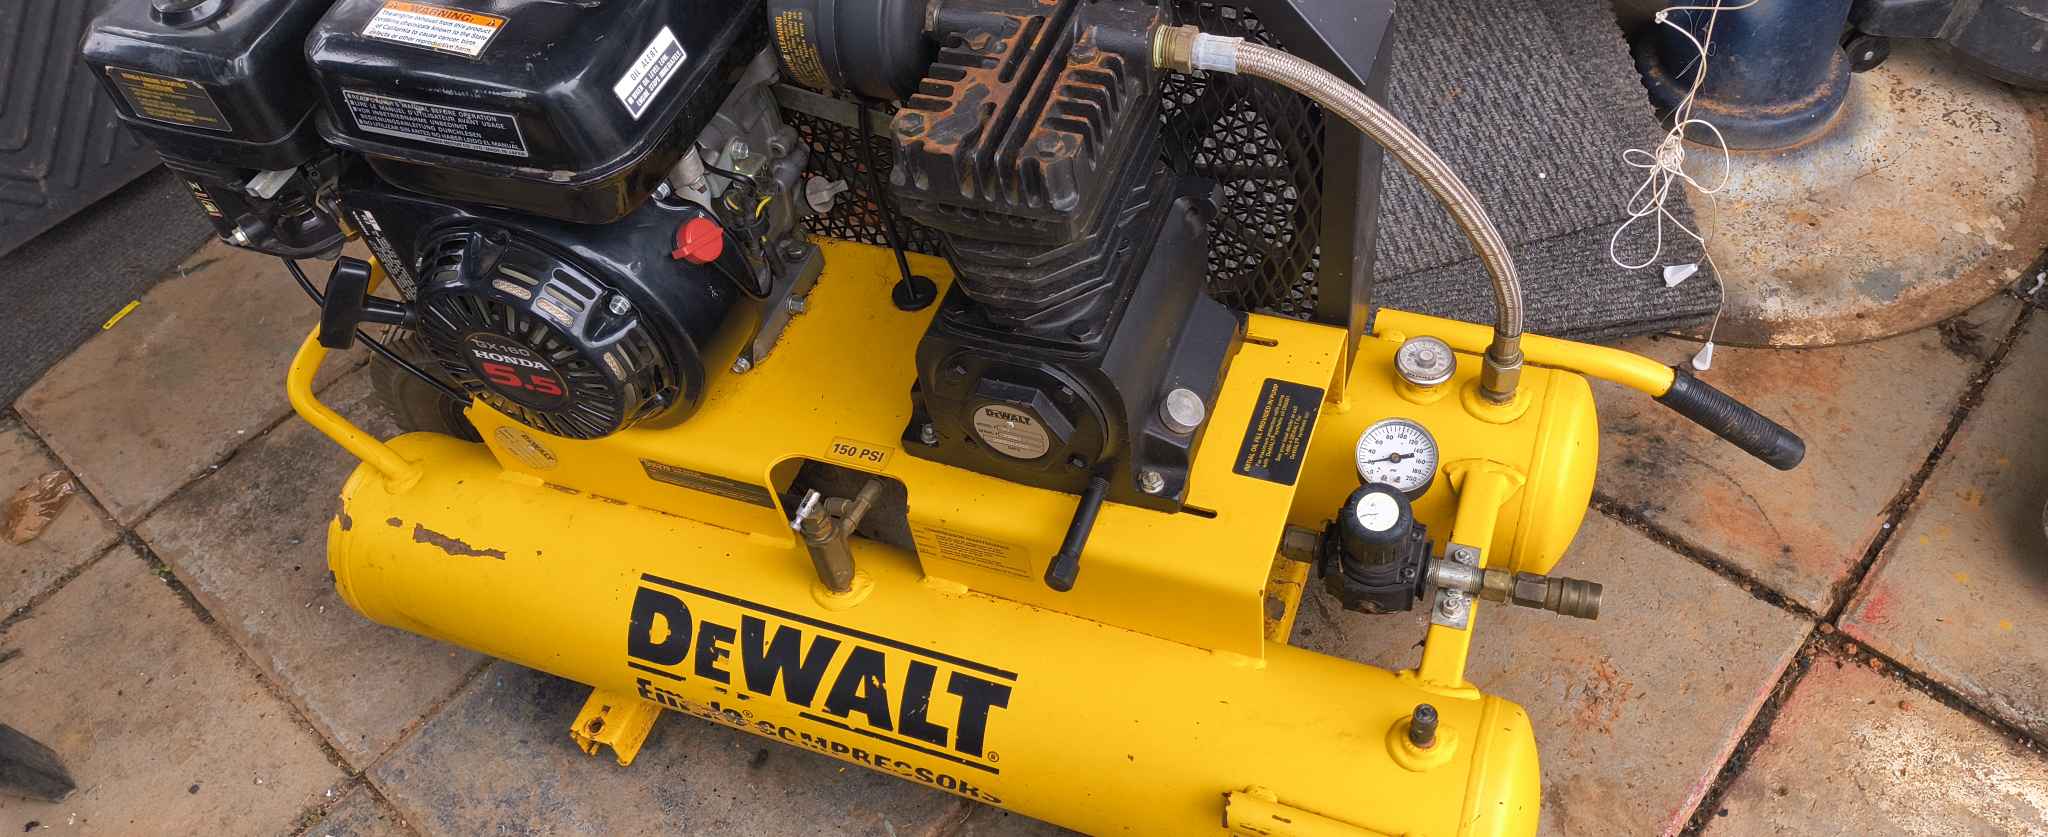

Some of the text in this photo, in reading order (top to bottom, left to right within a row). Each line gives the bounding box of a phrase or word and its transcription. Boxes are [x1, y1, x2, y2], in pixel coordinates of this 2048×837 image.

[381, 23, 412, 34] California
[630, 47, 658, 81] OIL ALERT
[430, 107, 457, 116] BEFORE
[457, 111, 498, 122] OPERATION
[476, 340, 530, 357] GX160
[472, 350, 550, 371] HONDA
[483, 361, 563, 396] 5.5
[1398, 432, 1408, 440] 100
[832, 443, 885, 463] 150 PSI
